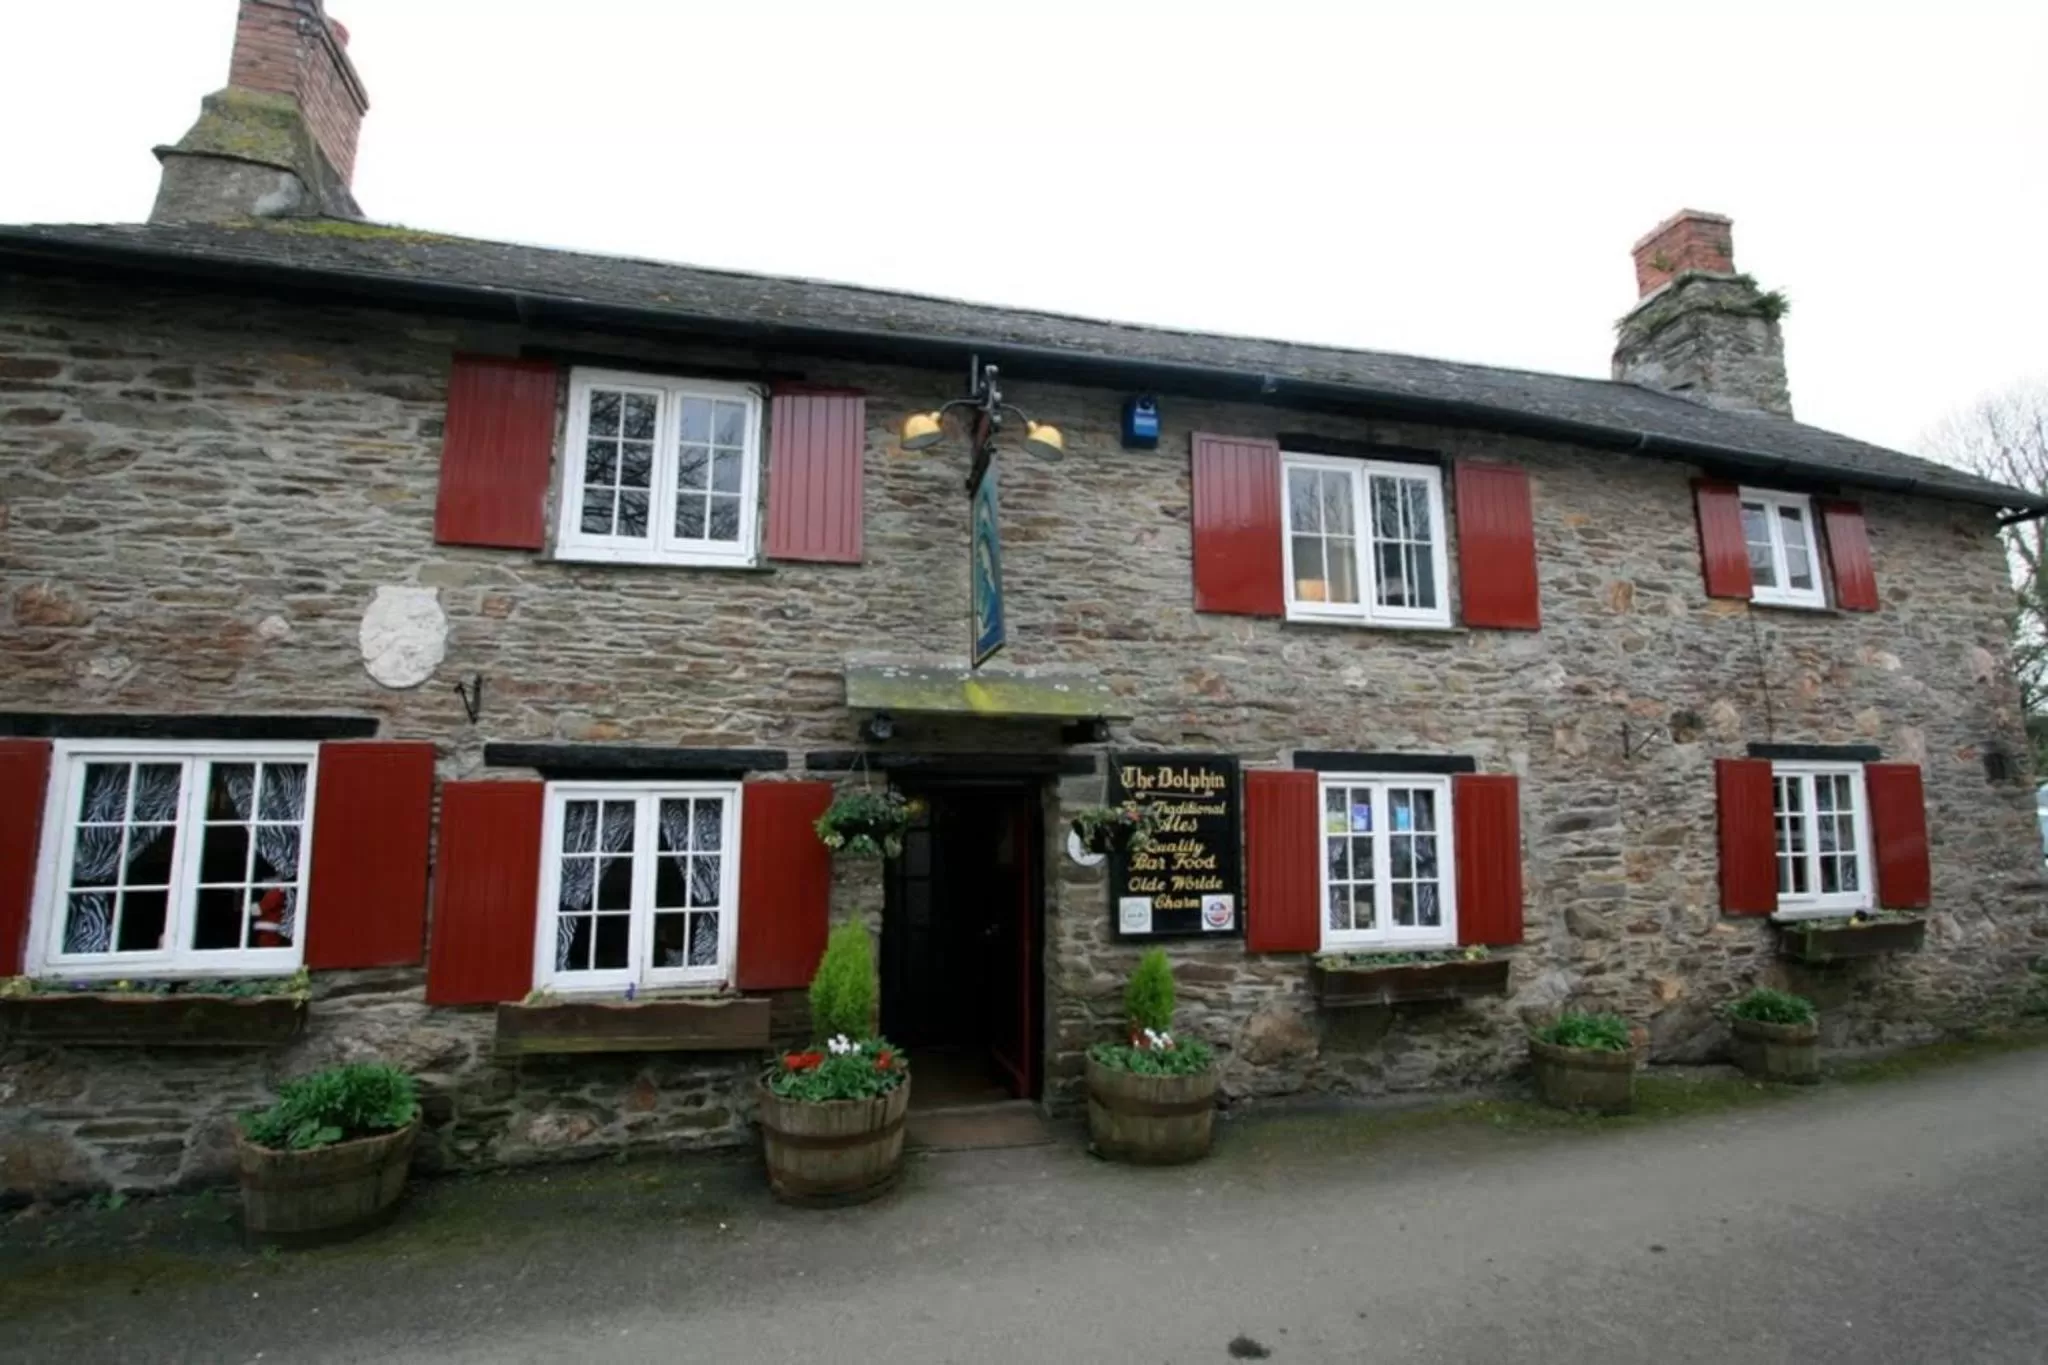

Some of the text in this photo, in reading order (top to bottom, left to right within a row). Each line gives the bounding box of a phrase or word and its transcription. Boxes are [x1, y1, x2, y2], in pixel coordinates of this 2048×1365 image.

[1121, 766, 1226, 793] The Dolphin
[1152, 801, 1227, 815] Traditional
[1155, 813, 1199, 833] Ales
[1143, 838, 1205, 858] Quality
[1128, 852, 1216, 871] Bar Food
[1128, 876, 1223, 892] Olde Worlde
[1153, 893, 1201, 910] Charm
